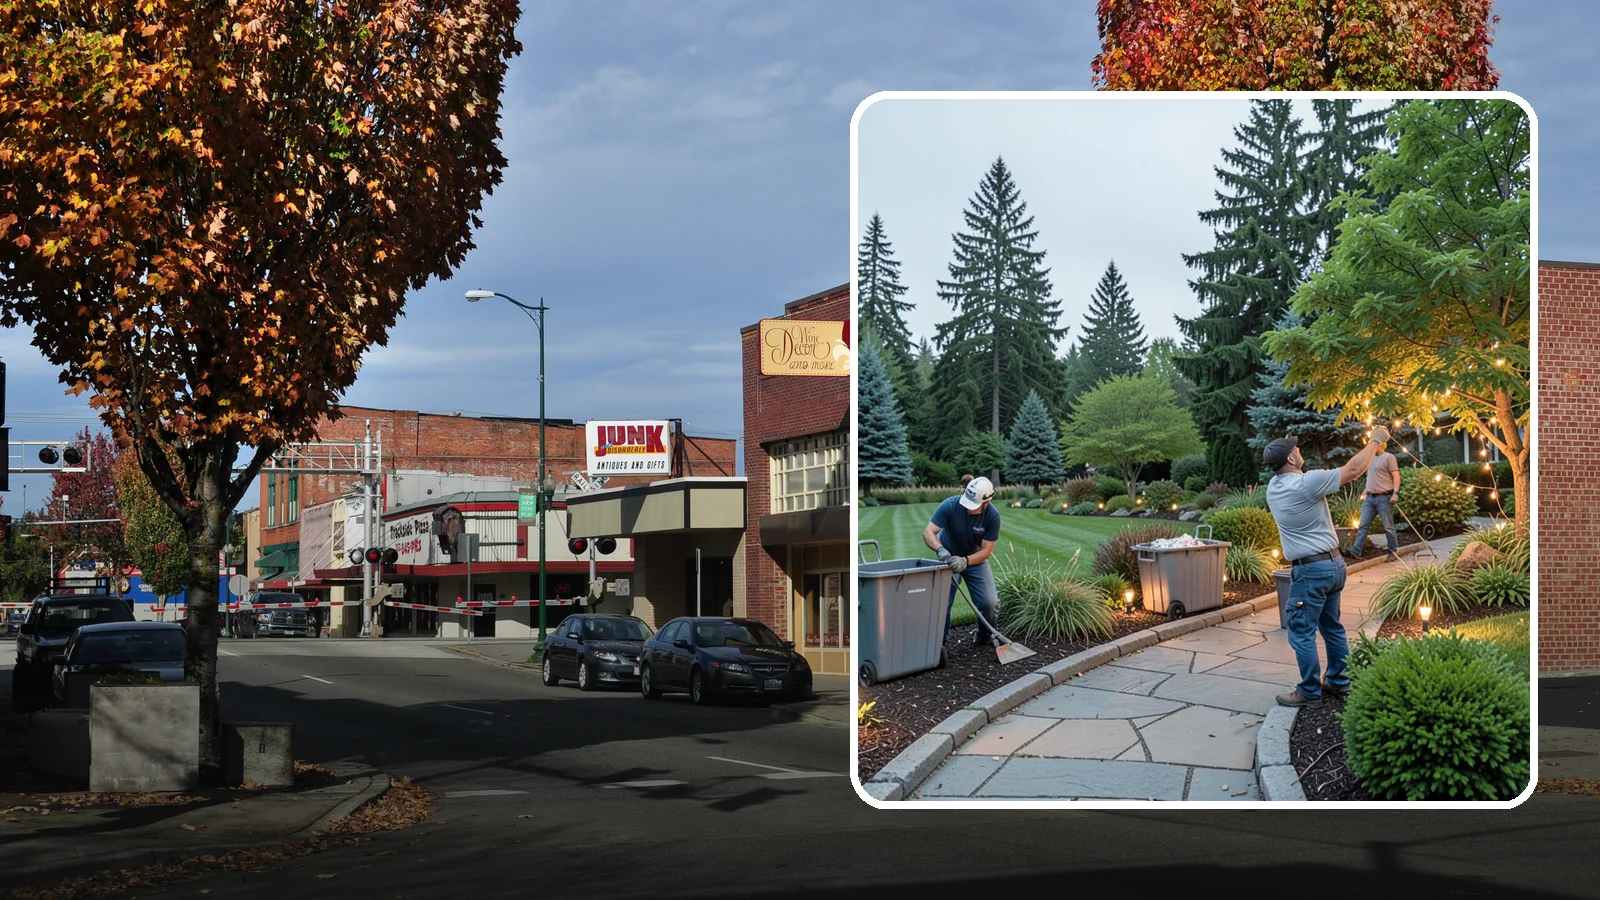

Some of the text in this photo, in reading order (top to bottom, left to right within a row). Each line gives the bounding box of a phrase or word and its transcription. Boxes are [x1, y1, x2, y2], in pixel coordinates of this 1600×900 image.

[791, 325, 824, 345] Wine
[765, 327, 831, 365] Decor
[595, 425, 666, 458] JUNK
[607, 446, 646, 454] DISORDERLY
[596, 460, 665, 470] ANTIQUES AND GIFTS
[352, 498, 365, 511] CRO
[414, 519, 429, 535] Pizza
